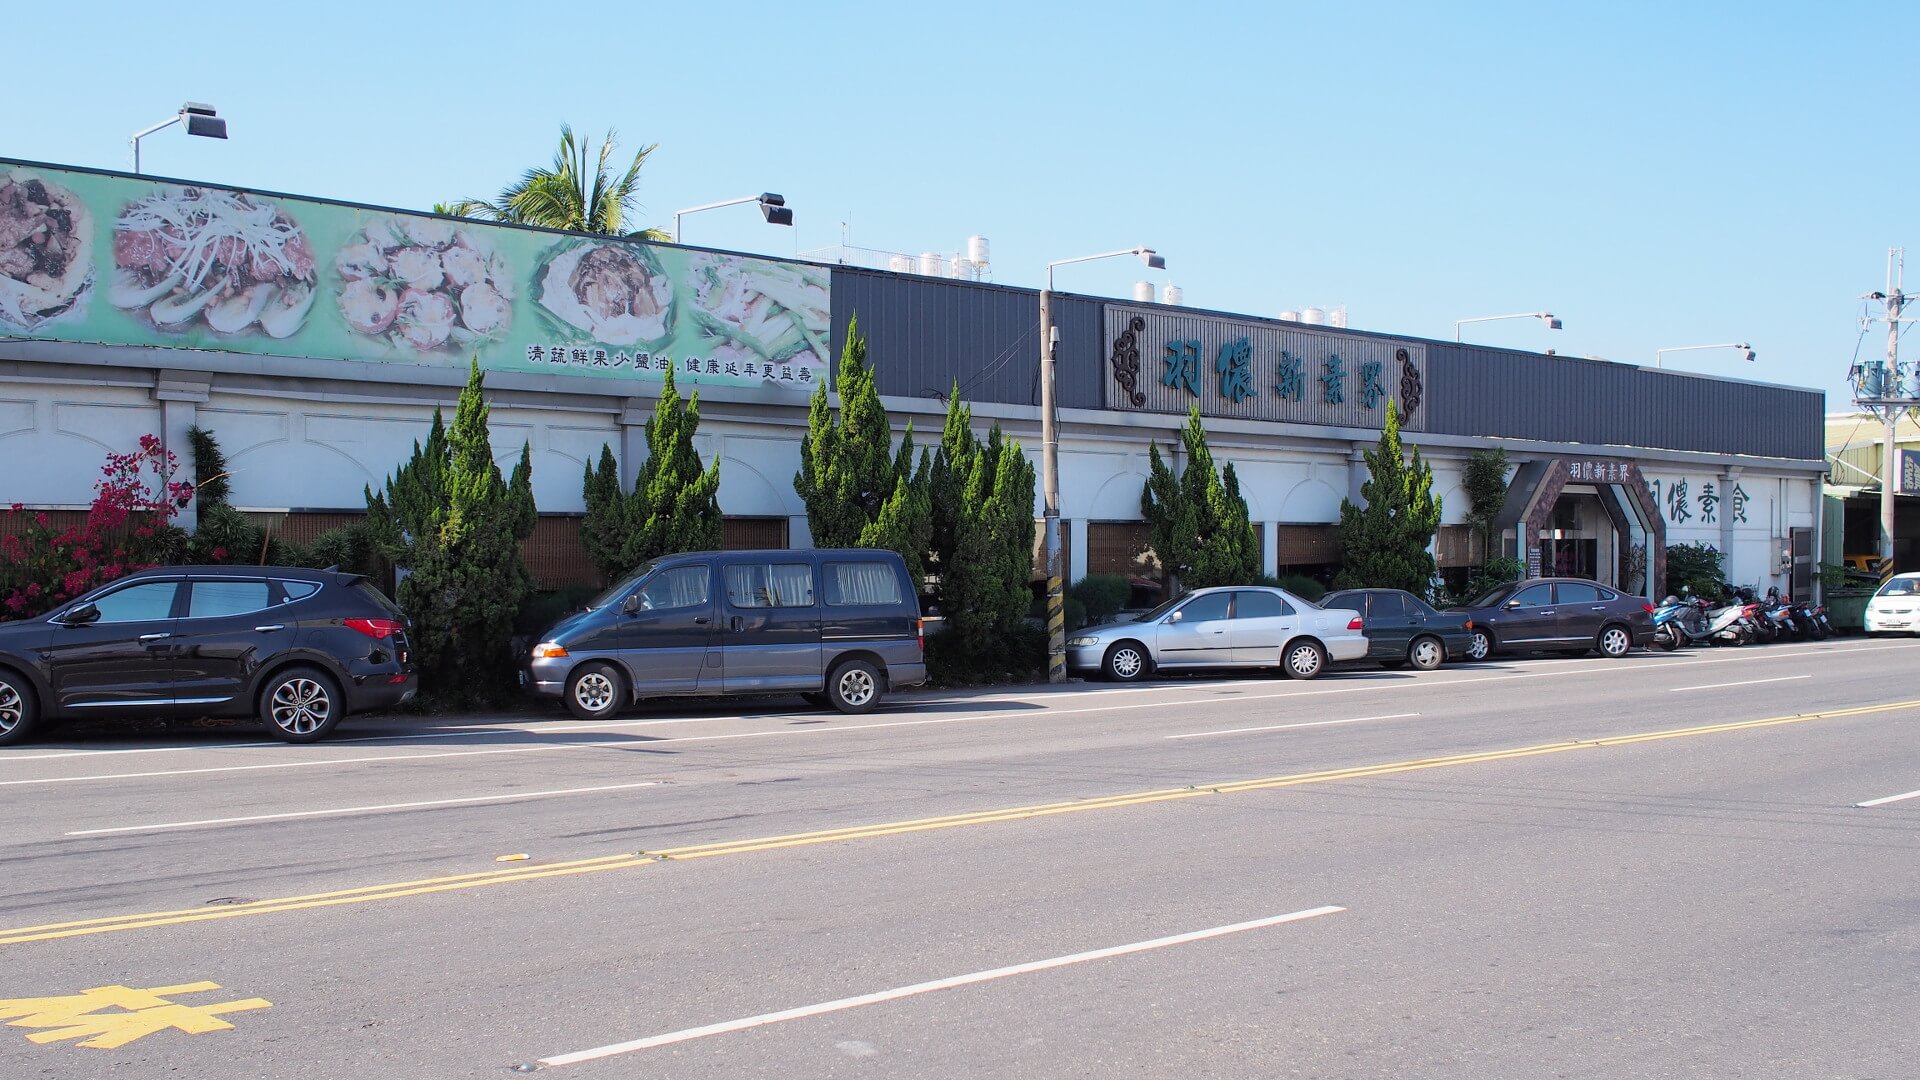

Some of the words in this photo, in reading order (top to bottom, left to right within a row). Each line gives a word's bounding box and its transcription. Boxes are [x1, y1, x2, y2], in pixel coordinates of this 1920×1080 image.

[1163, 337, 1385, 409] 羽儂新素界
[1569, 460, 1630, 482] 羽儂新素界
